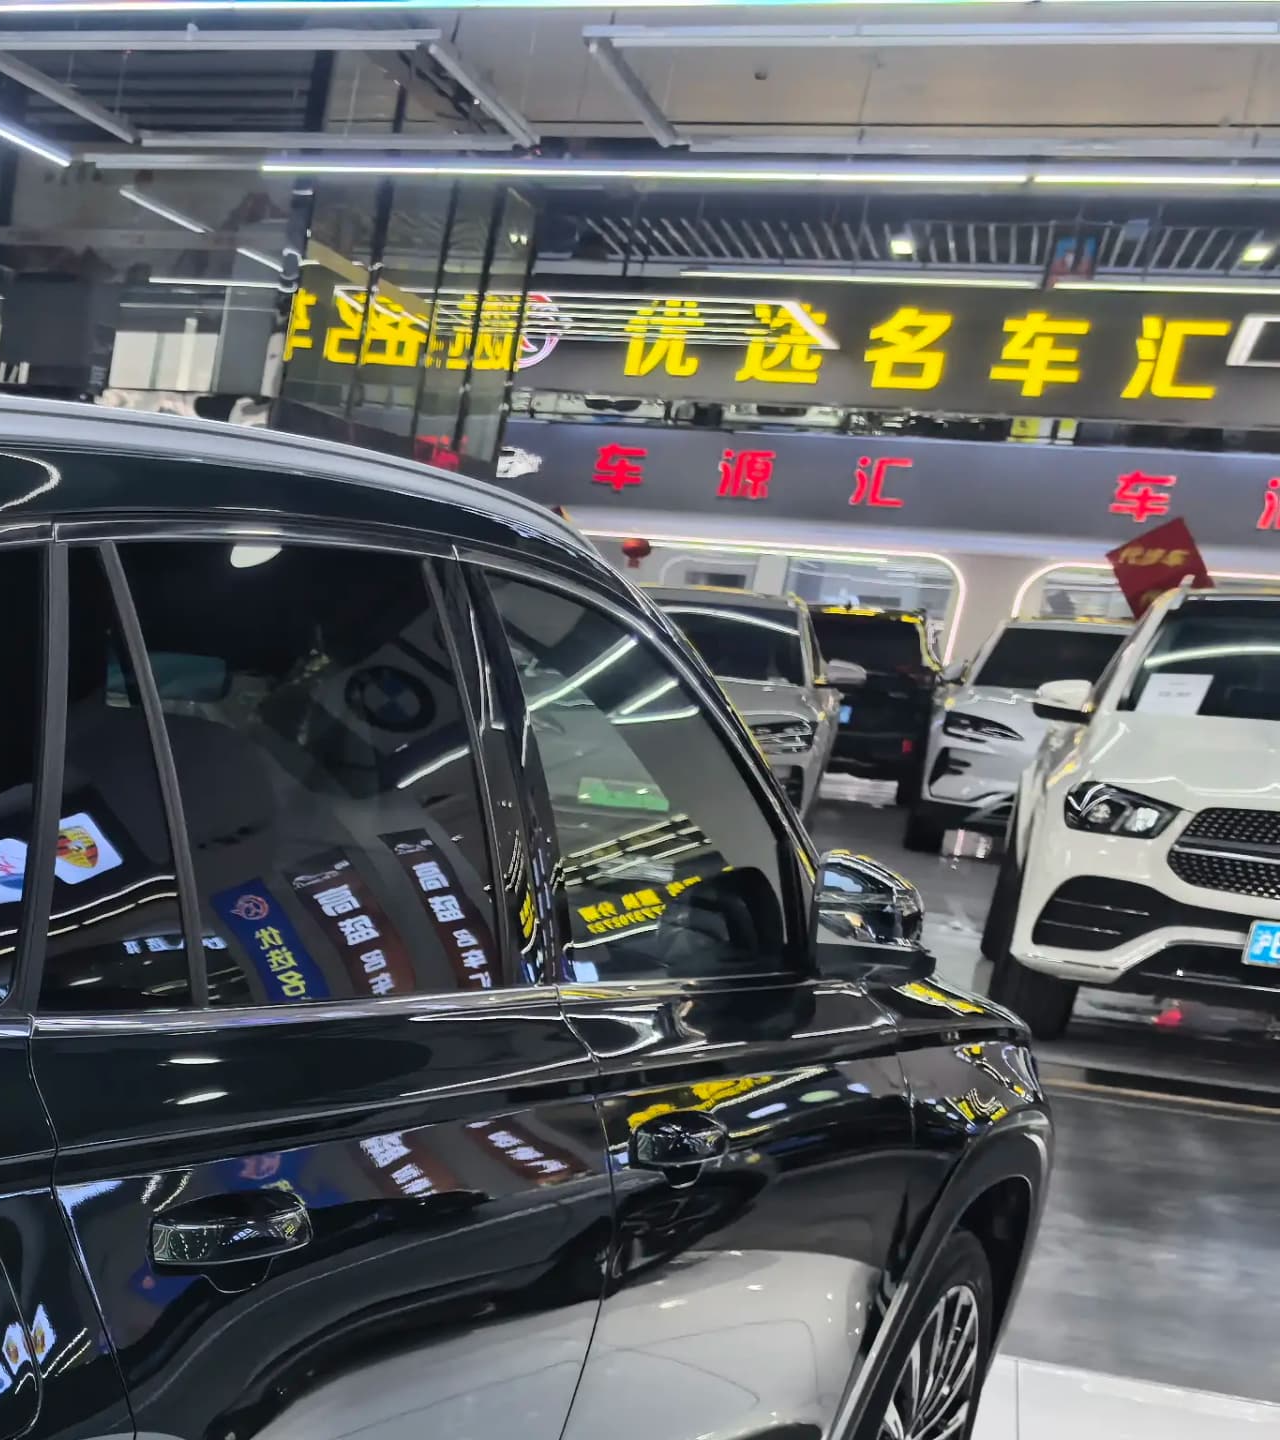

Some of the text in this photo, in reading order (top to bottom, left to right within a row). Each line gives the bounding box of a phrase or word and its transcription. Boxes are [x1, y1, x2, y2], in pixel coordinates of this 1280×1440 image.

[624, 298, 1234, 400] 优选名车汇
[591, 442, 914, 508] 车源汇
